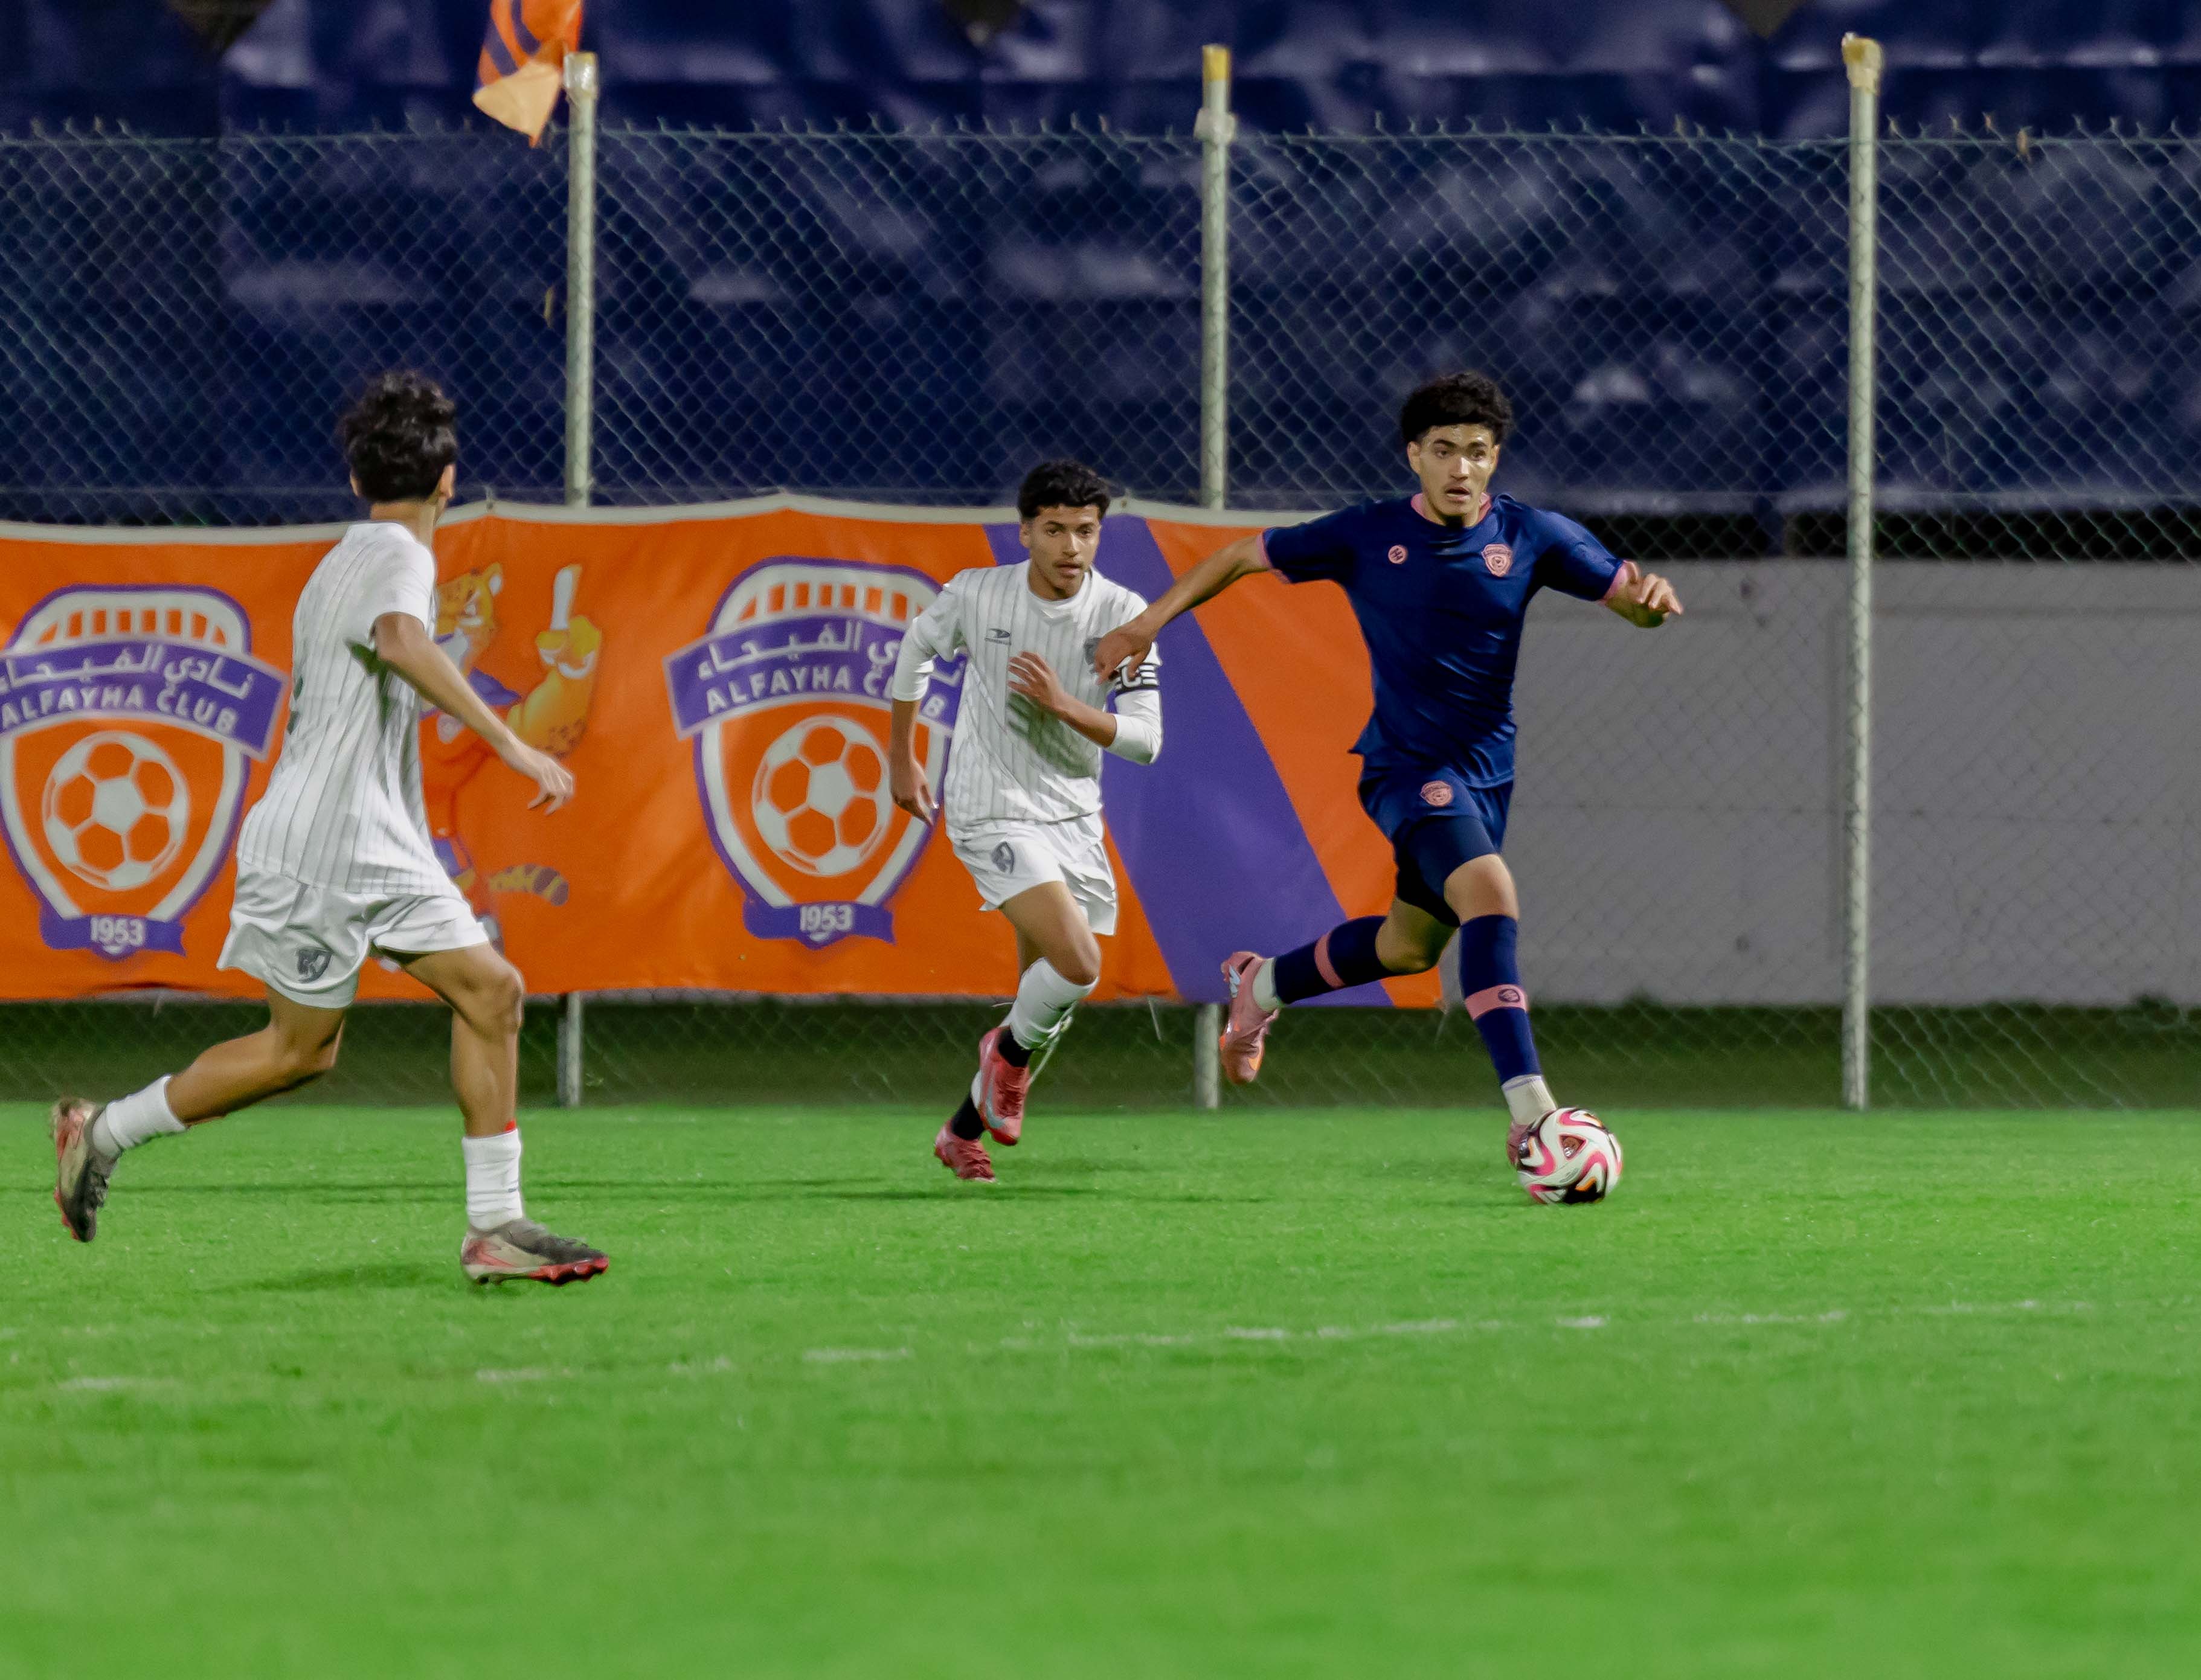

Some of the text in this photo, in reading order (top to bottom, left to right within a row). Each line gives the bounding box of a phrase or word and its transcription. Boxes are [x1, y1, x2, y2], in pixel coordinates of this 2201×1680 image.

[698, 620, 863, 681] الفيحاء
[164, 655, 254, 699] نادي
[707, 666, 945, 717] ALFAYHA CLB
[2, 684, 239, 735] ALFAYHA CLUB
[91, 915, 144, 947] 1953
[800, 904, 852, 932] 1953
